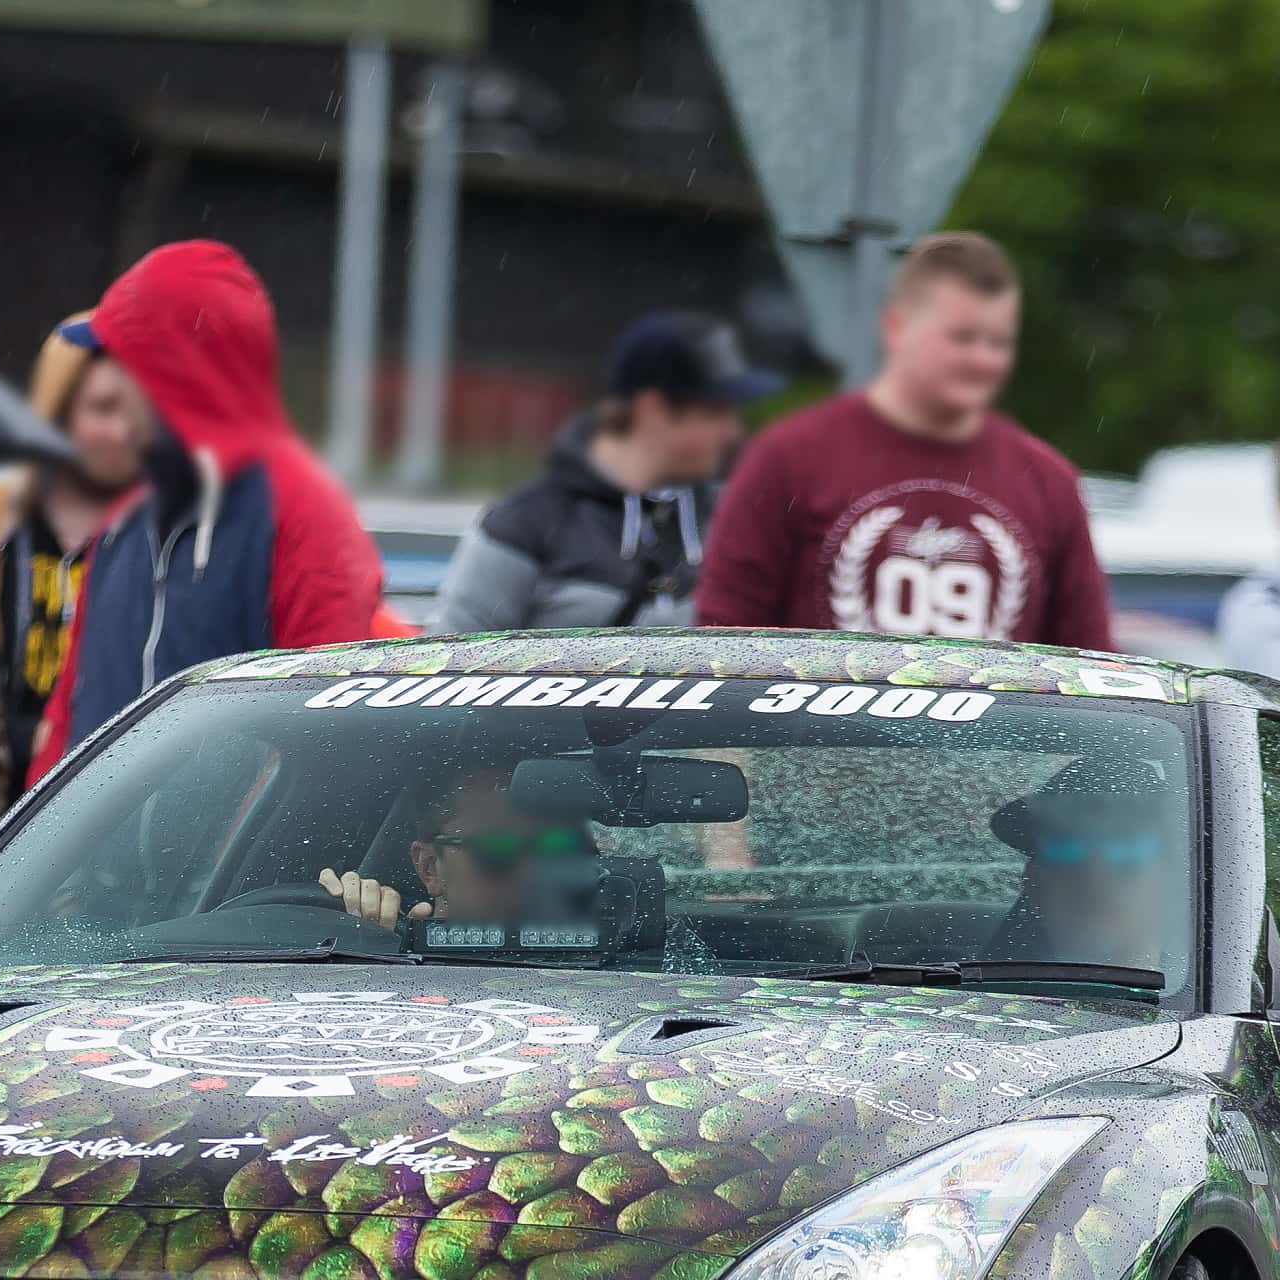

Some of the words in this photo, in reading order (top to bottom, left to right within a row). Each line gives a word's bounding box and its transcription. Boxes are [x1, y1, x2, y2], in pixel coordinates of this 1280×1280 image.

[874, 556, 992, 636] 09
[303, 676, 725, 711] GUMBALL
[747, 683, 996, 722] 3000
